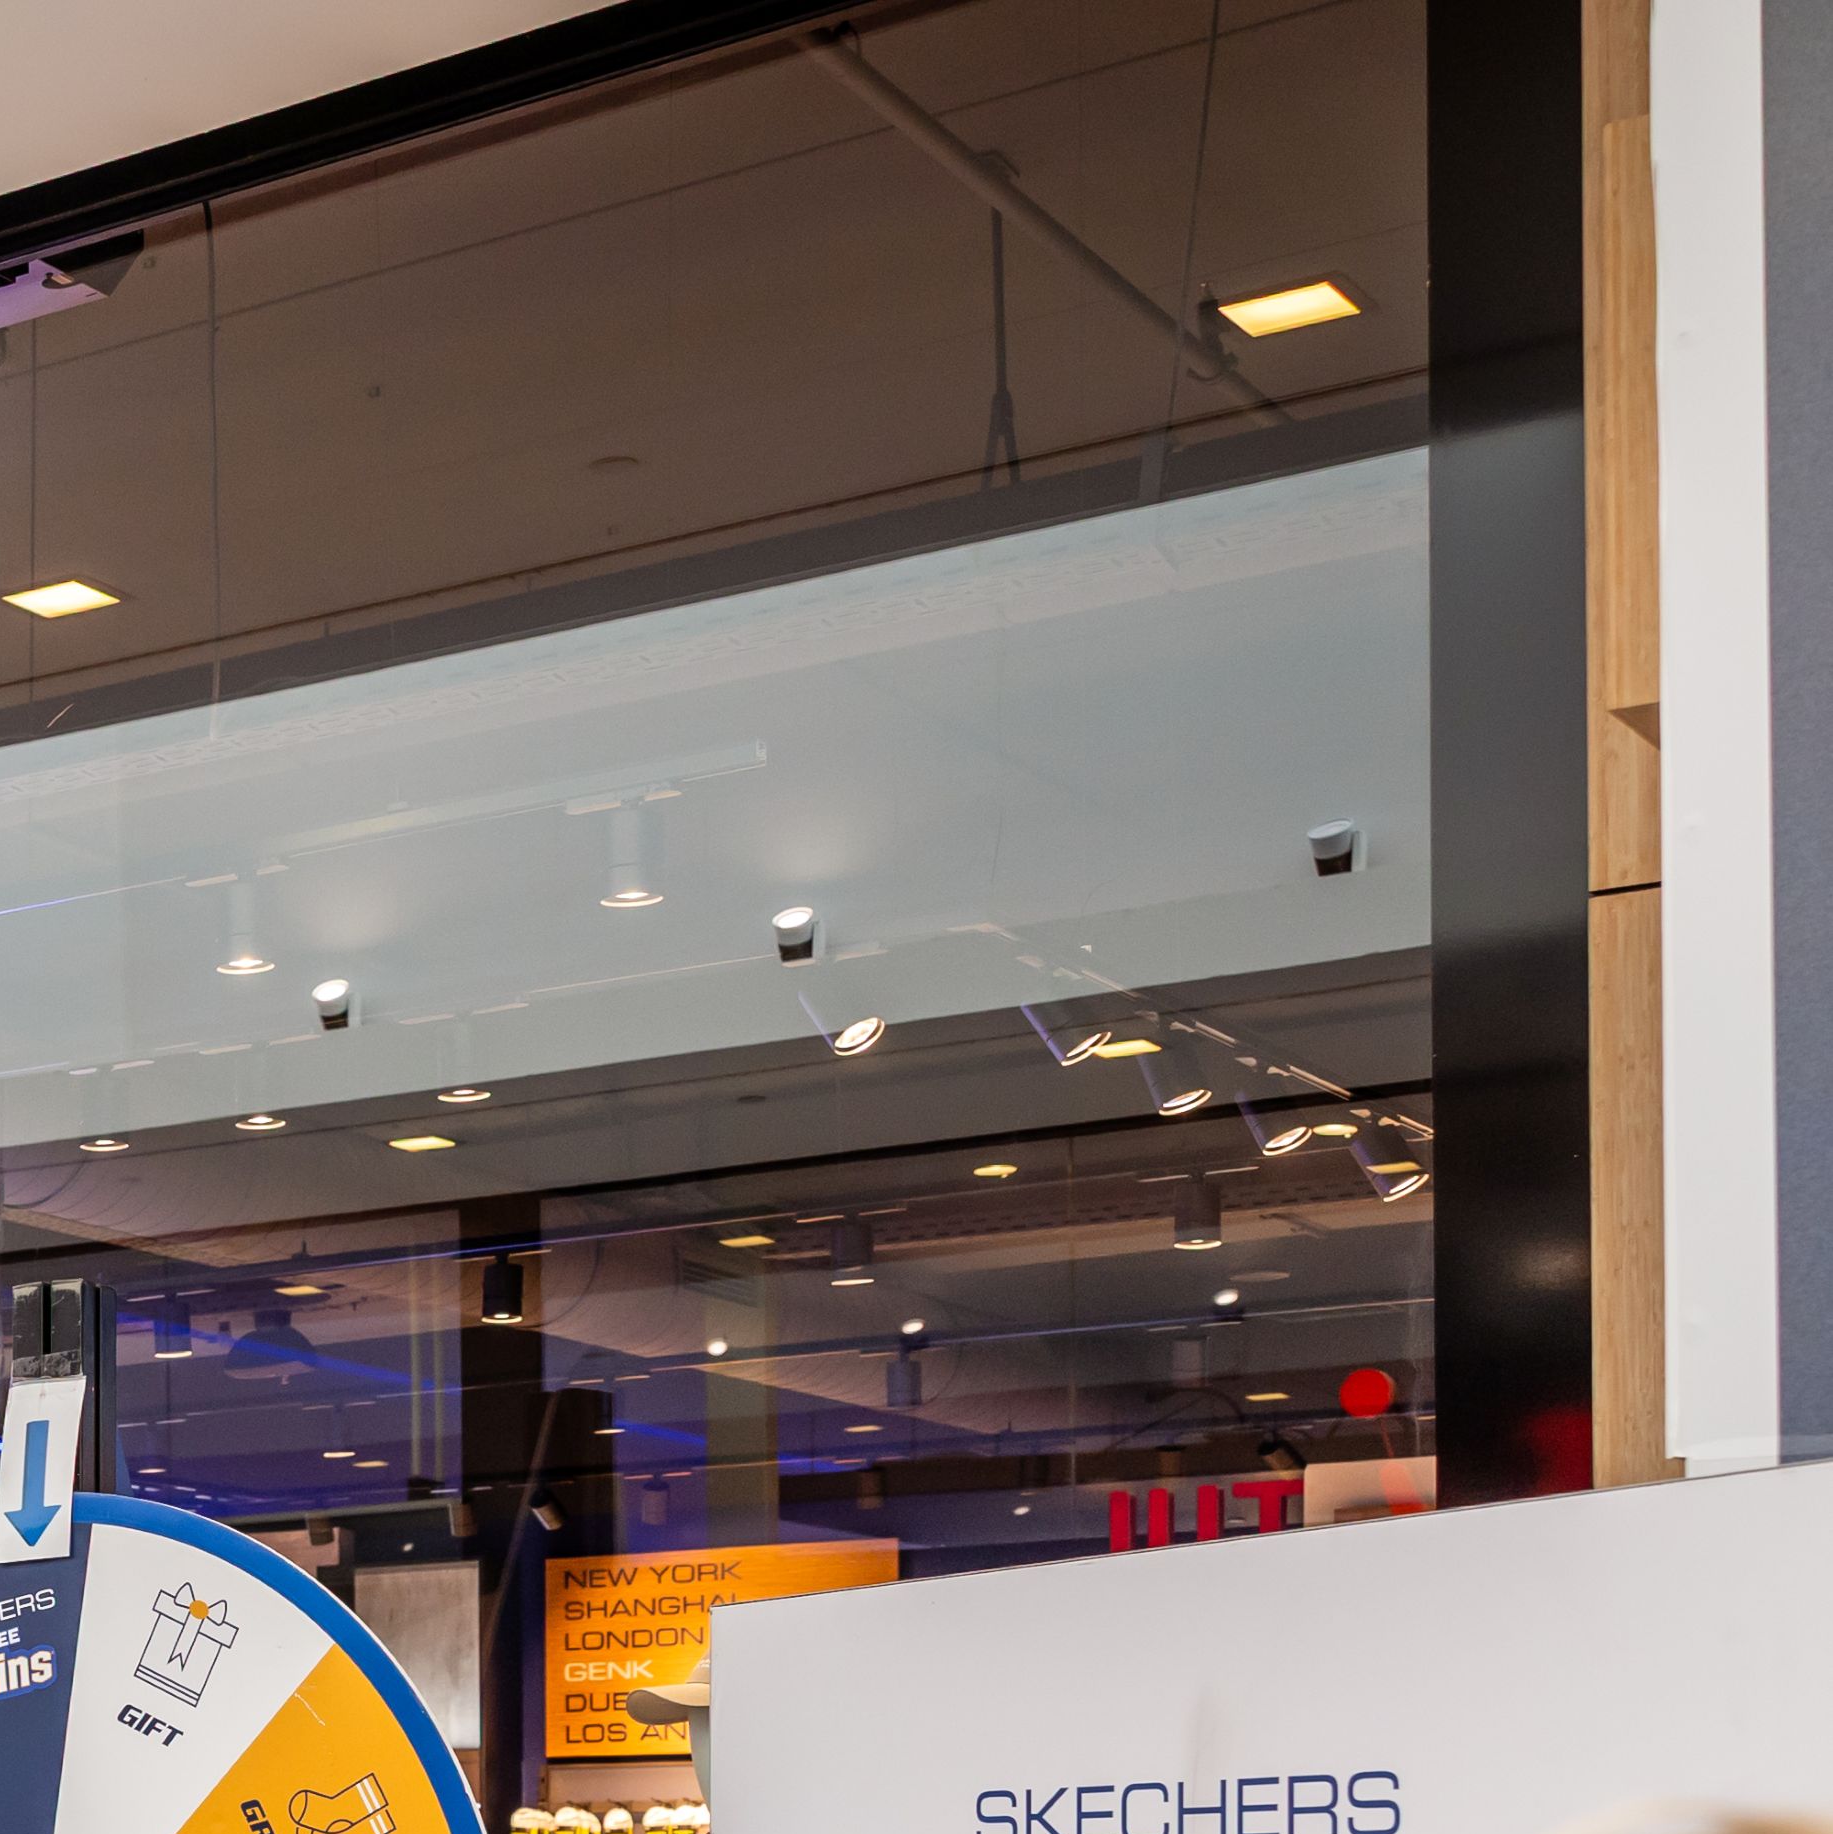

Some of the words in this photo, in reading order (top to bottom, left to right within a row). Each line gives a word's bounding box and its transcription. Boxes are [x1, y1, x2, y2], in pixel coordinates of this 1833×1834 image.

[564, 1567, 637, 1590] NEW
[649, 1560, 743, 1584] YORK
[564, 1627, 704, 1651] LONDON
[564, 1659, 654, 1682] GENK
[117, 1704, 184, 1747] GIFT
[566, 1723, 627, 1744] LOS
